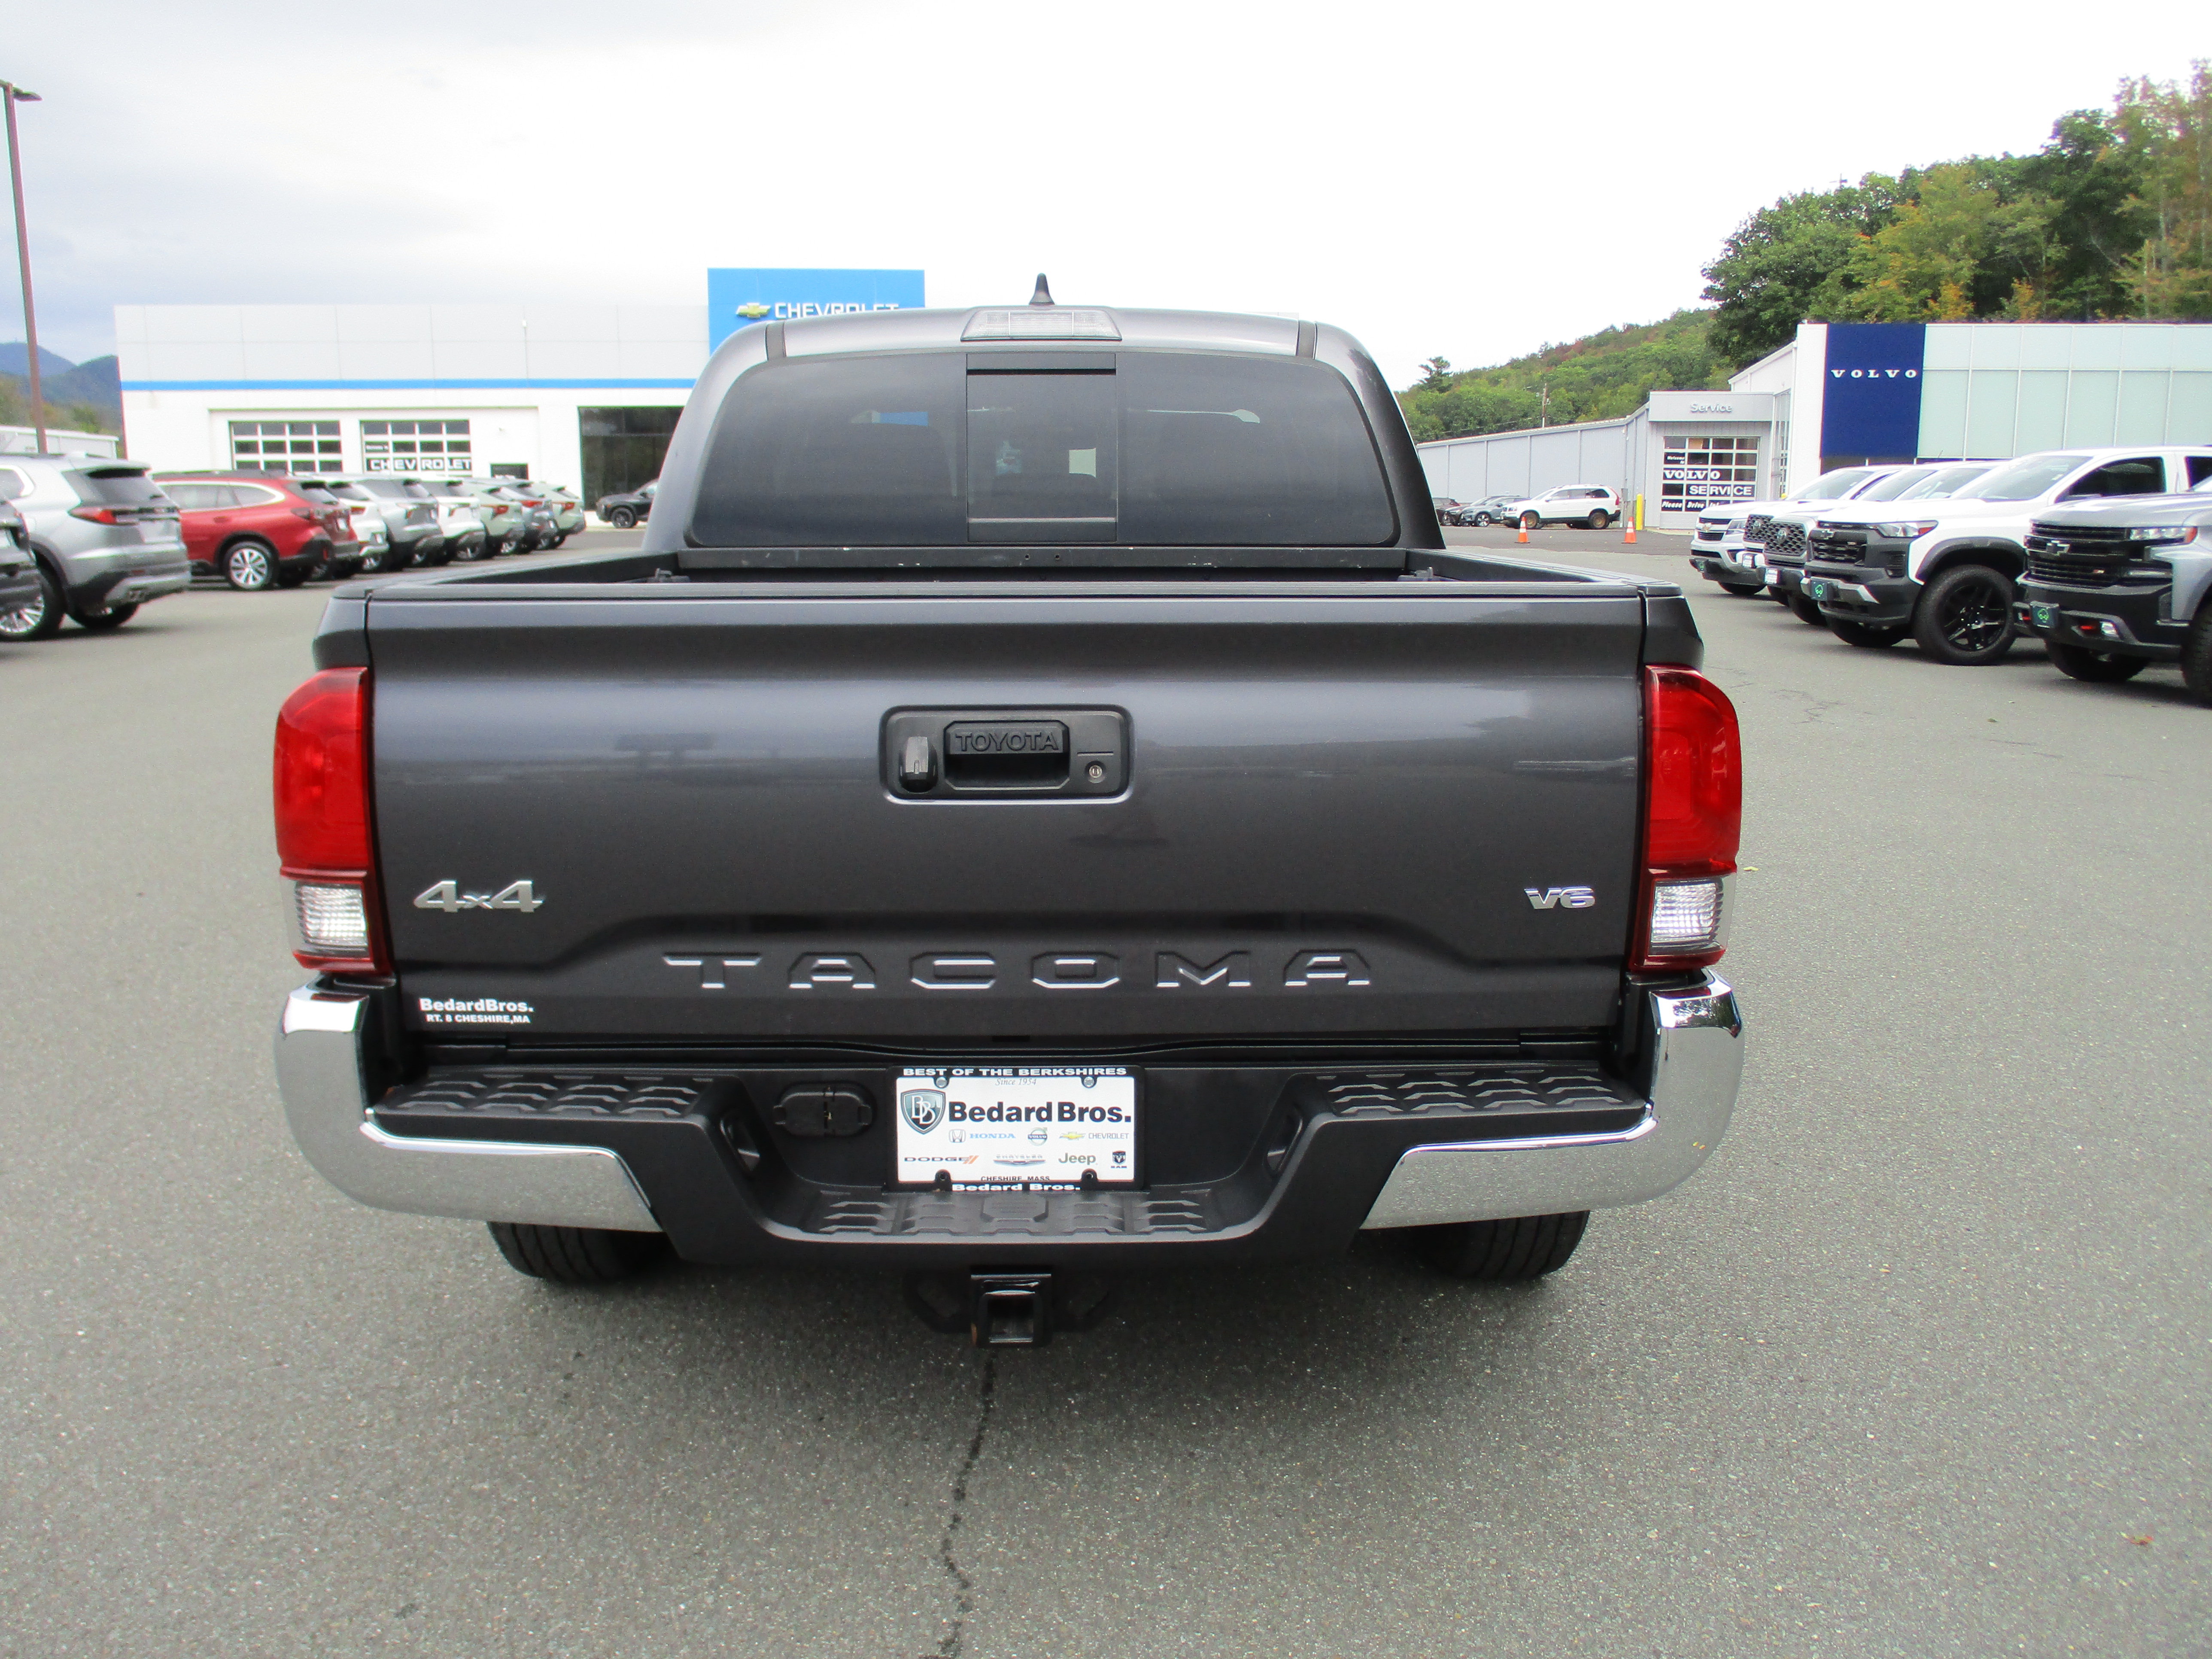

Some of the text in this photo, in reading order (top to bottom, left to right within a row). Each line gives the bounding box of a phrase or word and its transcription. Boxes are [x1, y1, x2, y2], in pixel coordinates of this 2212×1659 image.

[1831, 369, 1917, 378] VOLVO
[1690, 403, 1732, 413] Service
[370, 459, 471, 470] CHEVROLET
[1663, 470, 1721, 479] VOLVO
[1689, 485, 1752, 495] SERVICE
[955, 732, 1059, 751] TOYOTA
[1524, 886, 1595, 909] V6
[662, 949, 1370, 988] TACOMA
[425, 1013, 443, 1022] RT.
[995, 1078, 1015, 1086] Since
[948, 1101, 1131, 1122] Bedard Bros.
[1058, 1153, 1096, 1165] Jeep
[952, 1183, 1023, 1191] Bedard
